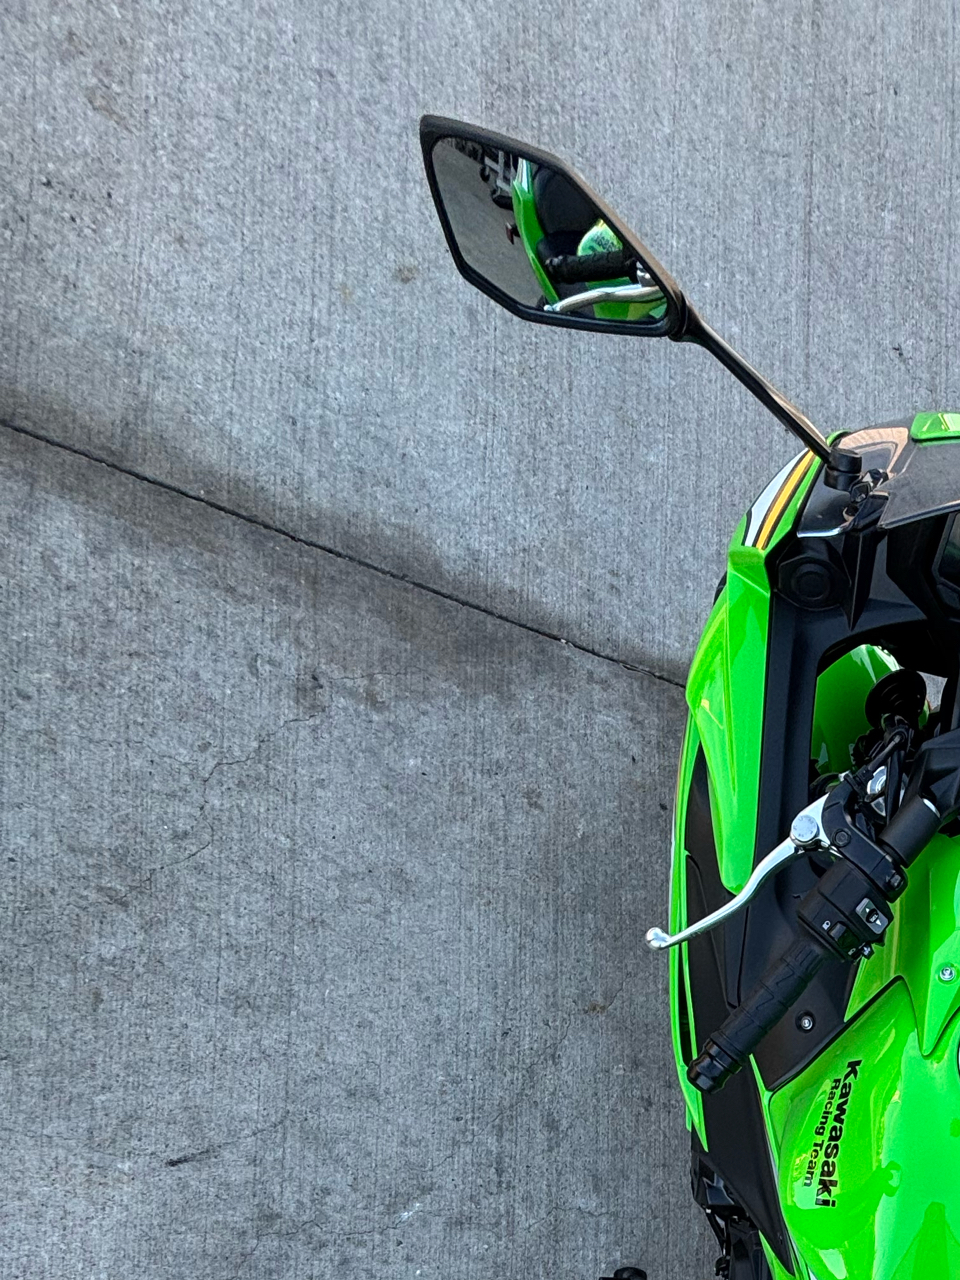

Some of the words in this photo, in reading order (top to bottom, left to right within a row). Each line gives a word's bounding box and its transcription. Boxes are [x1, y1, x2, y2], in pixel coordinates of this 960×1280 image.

[814, 1078, 842, 1136] Racing
[814, 1059, 863, 1208] Kawasaki
[802, 1140, 825, 1188] Team
